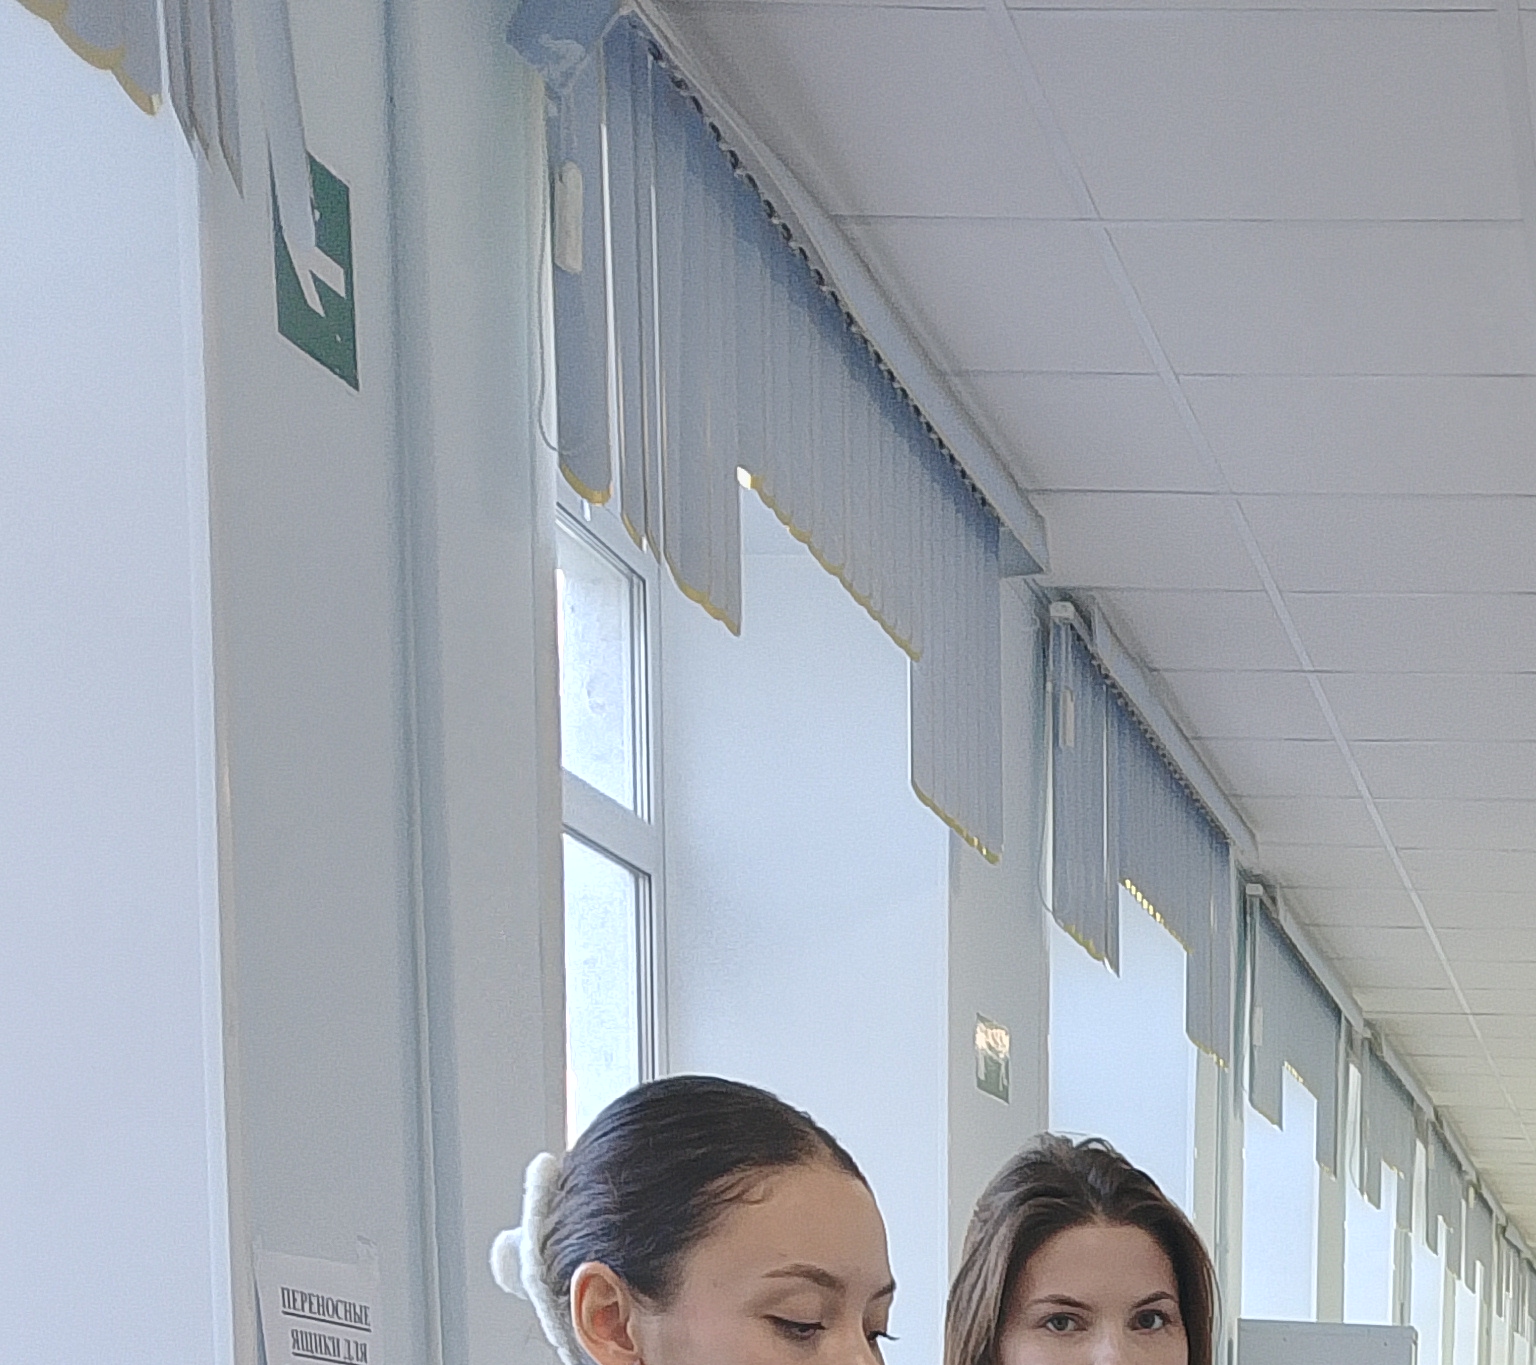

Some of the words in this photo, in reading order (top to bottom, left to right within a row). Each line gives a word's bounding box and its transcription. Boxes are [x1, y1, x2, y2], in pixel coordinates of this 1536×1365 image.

[281, 1286, 371, 1327] ПЕРЕНОСНЫЕ
[291, 1329, 341, 1358] ЯЩИКИ
[343, 1339, 369, 1364] ДЛЯ
